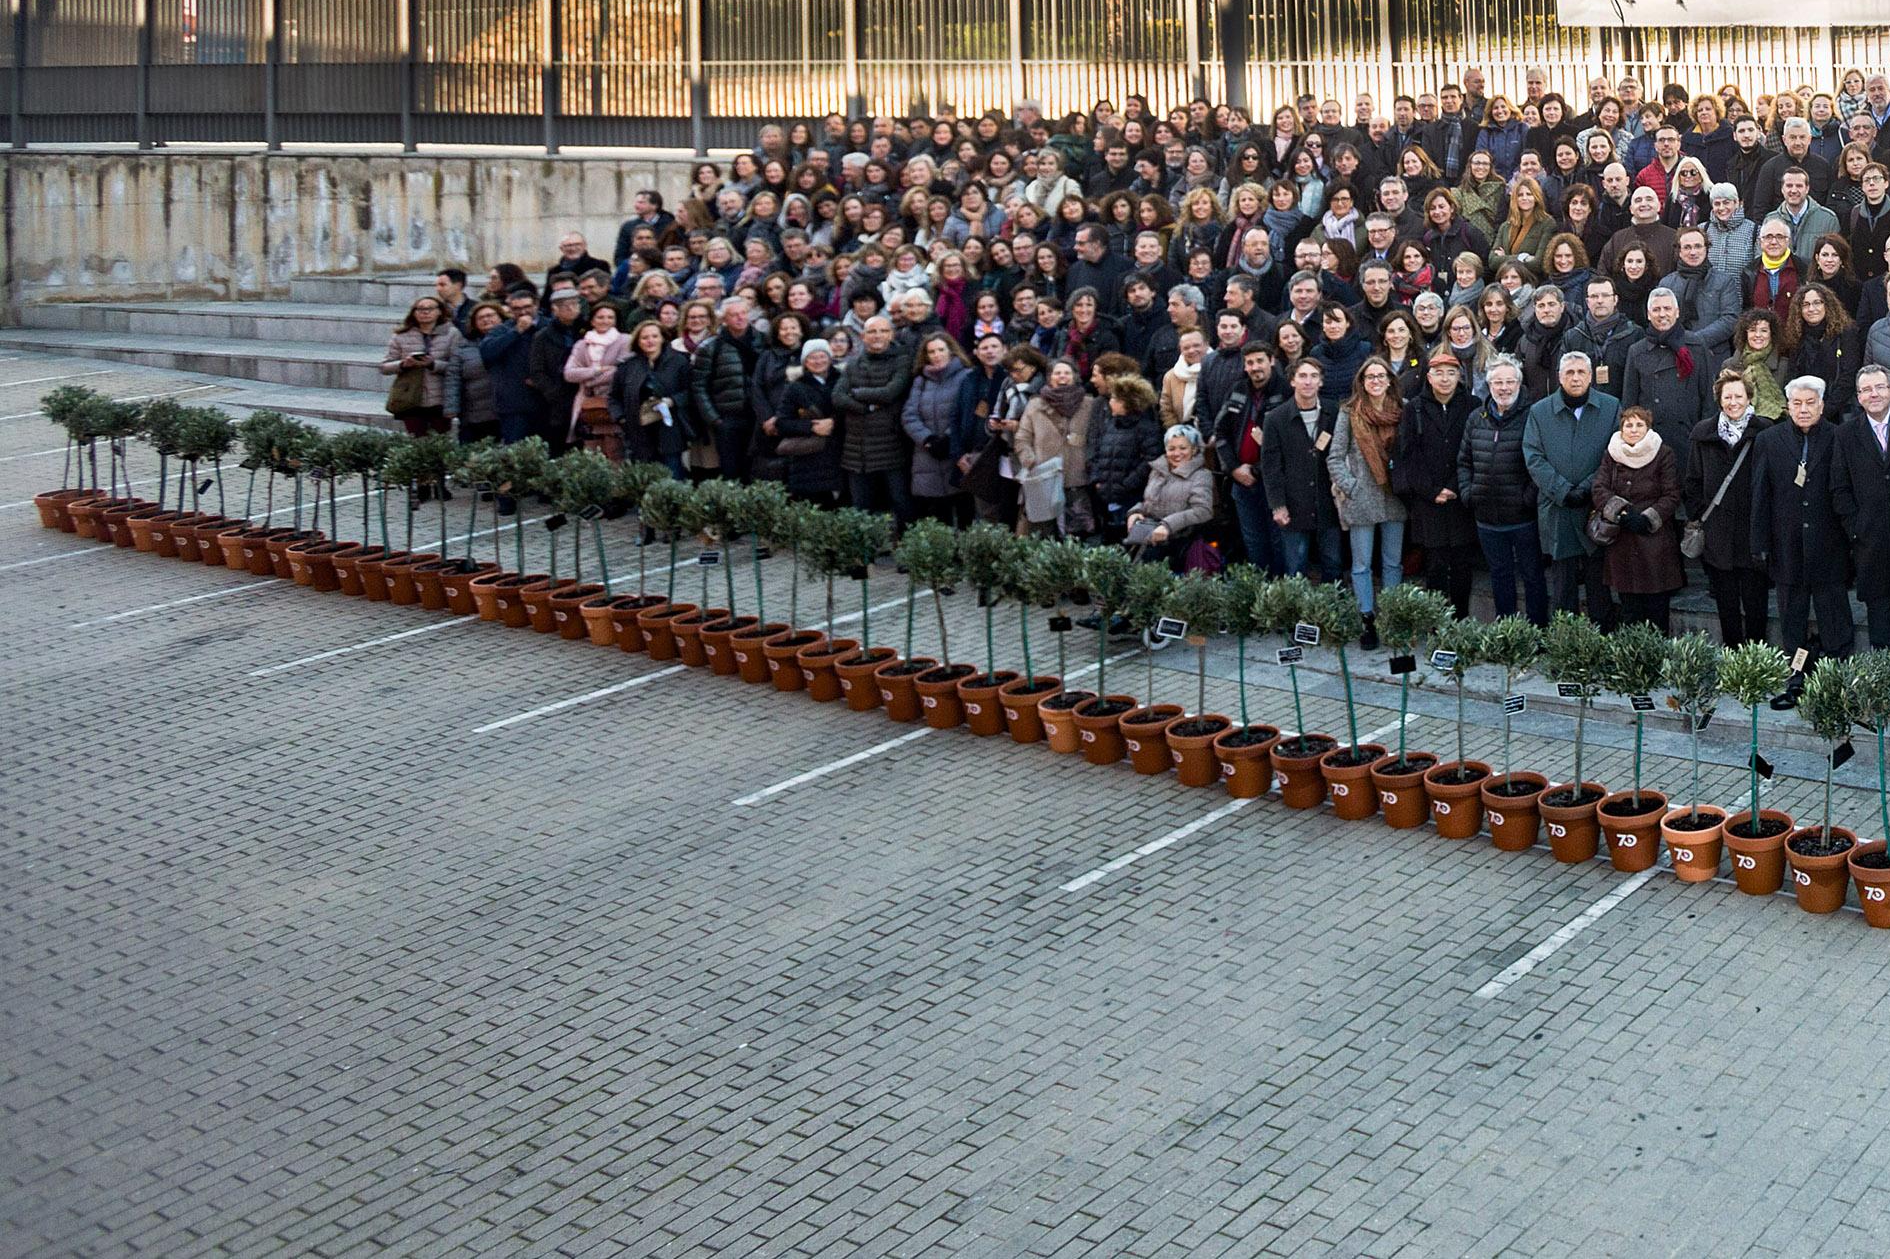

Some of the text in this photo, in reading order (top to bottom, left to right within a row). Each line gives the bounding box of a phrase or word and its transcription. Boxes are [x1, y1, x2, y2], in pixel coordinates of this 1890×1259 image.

[1737, 855, 1755, 869] 70
[1794, 869, 1810, 885] 70
[1865, 887, 1885, 901] 70
